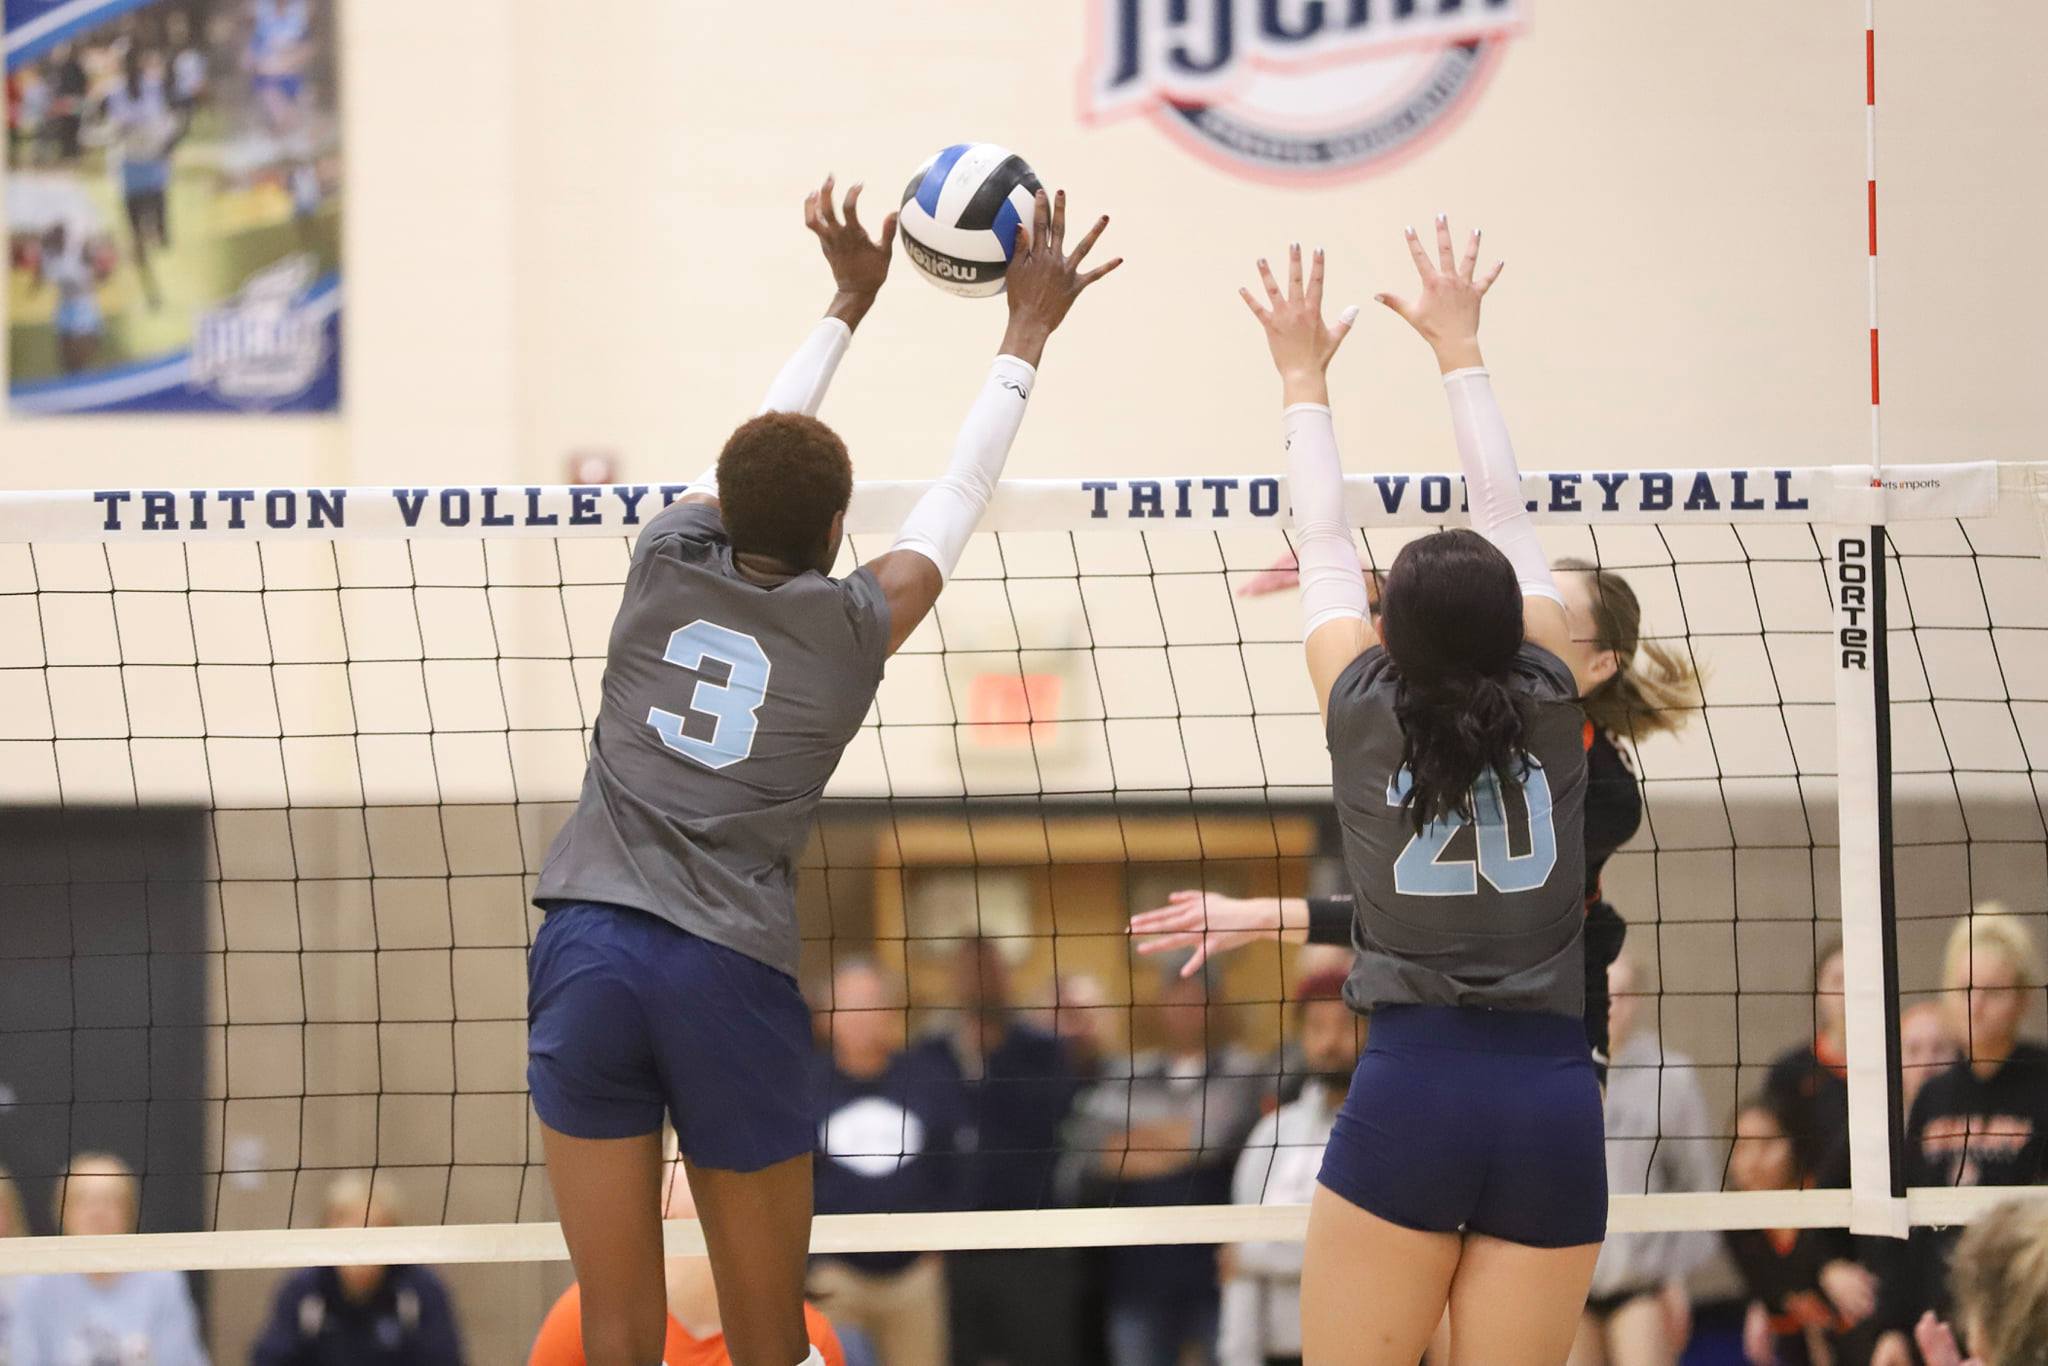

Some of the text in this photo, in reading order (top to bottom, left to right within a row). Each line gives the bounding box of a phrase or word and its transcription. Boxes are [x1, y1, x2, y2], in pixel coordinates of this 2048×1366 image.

[94, 489, 347, 531] TRITON
[1082, 470, 1809, 518] TRITO VOEYBALL
[646, 619, 771, 769] 3
[1386, 749, 1558, 896] 20
